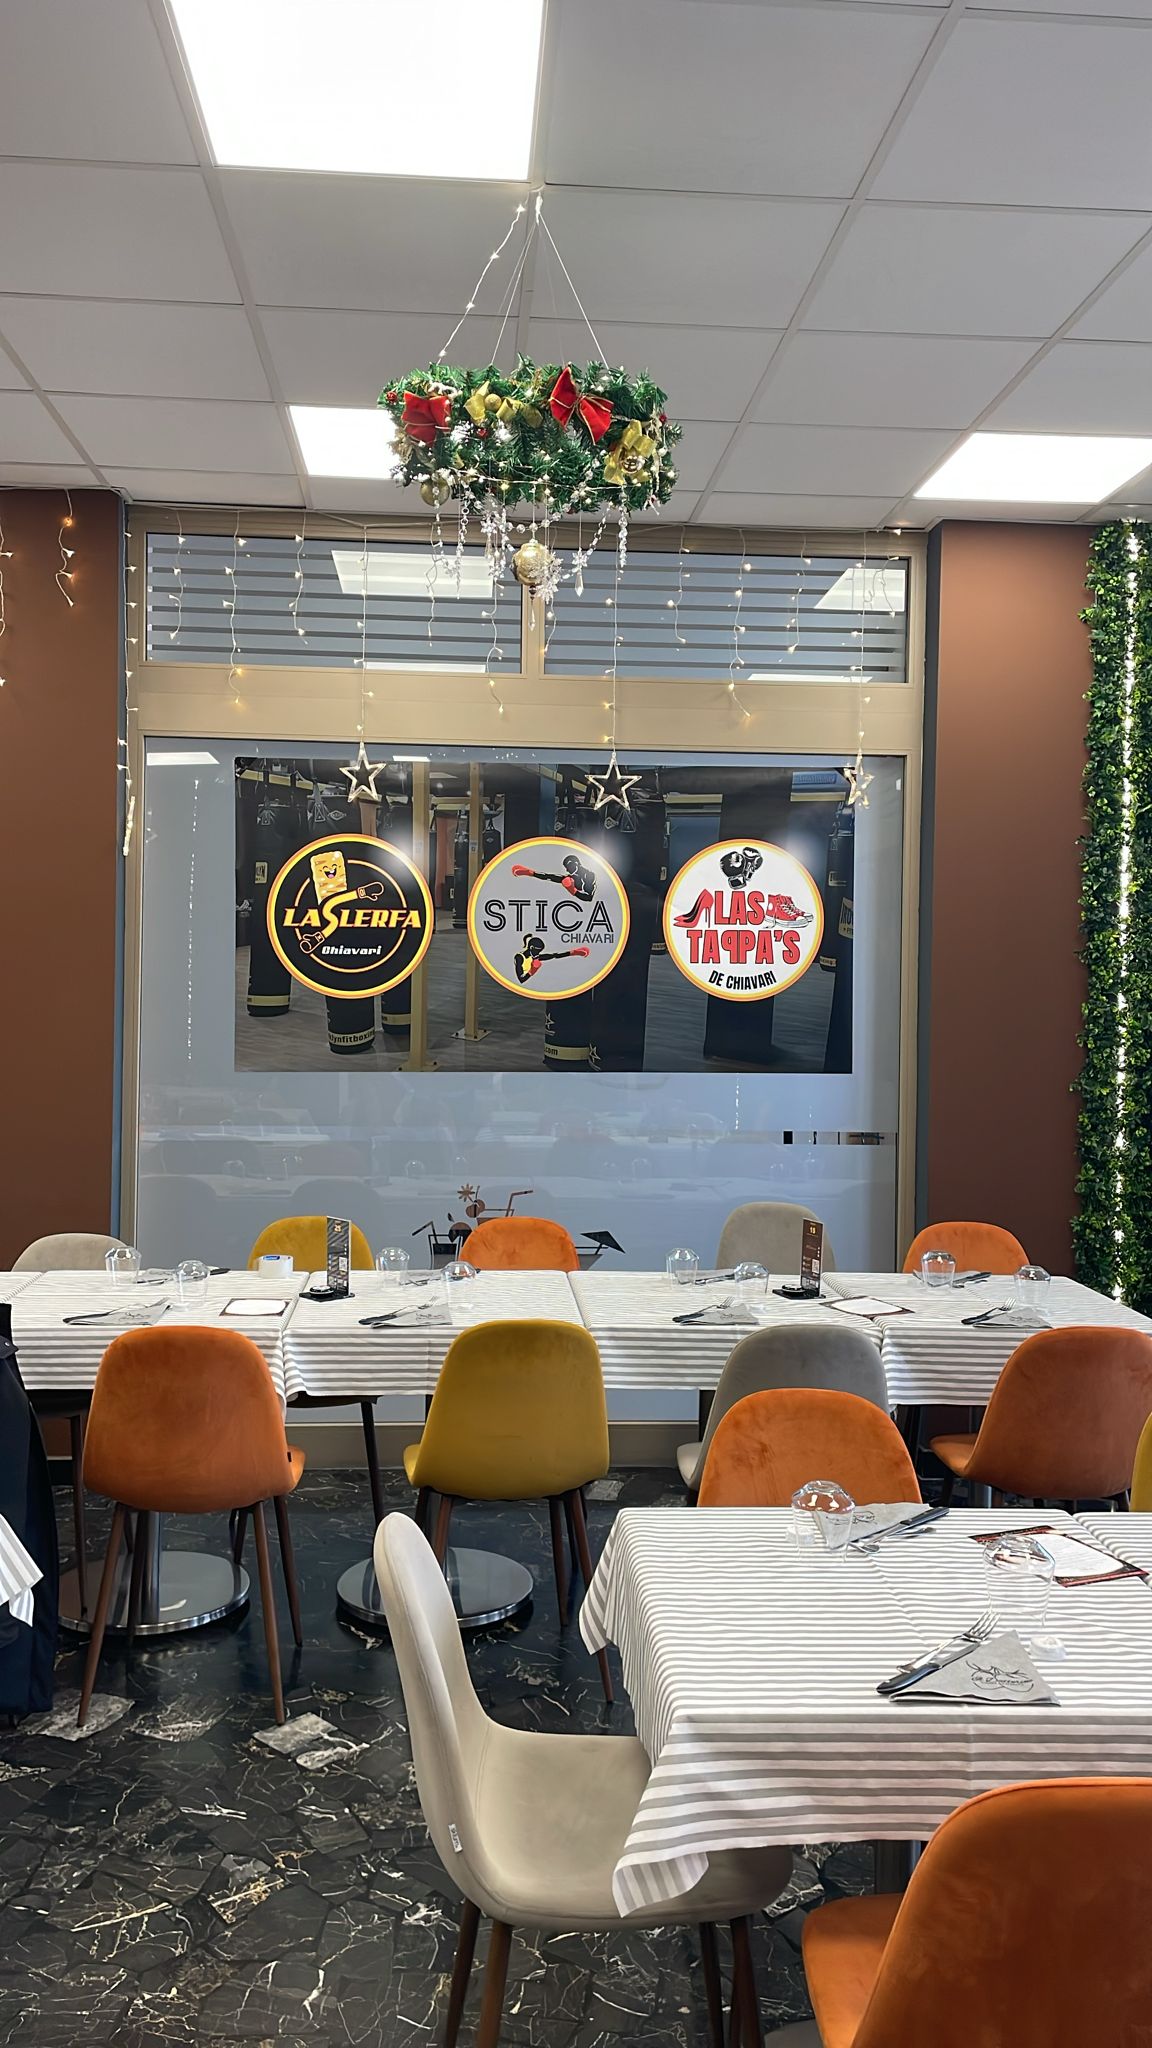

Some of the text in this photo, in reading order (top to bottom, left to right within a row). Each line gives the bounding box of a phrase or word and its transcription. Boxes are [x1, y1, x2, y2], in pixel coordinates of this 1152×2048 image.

[483, 899, 614, 933] STICA
[714, 890, 765, 926] LAS
[560, 933, 614, 944] CHIAVARI
[686, 929, 801, 965] TAPPA'S
[708, 970, 777, 990] DE CHIAVARI
